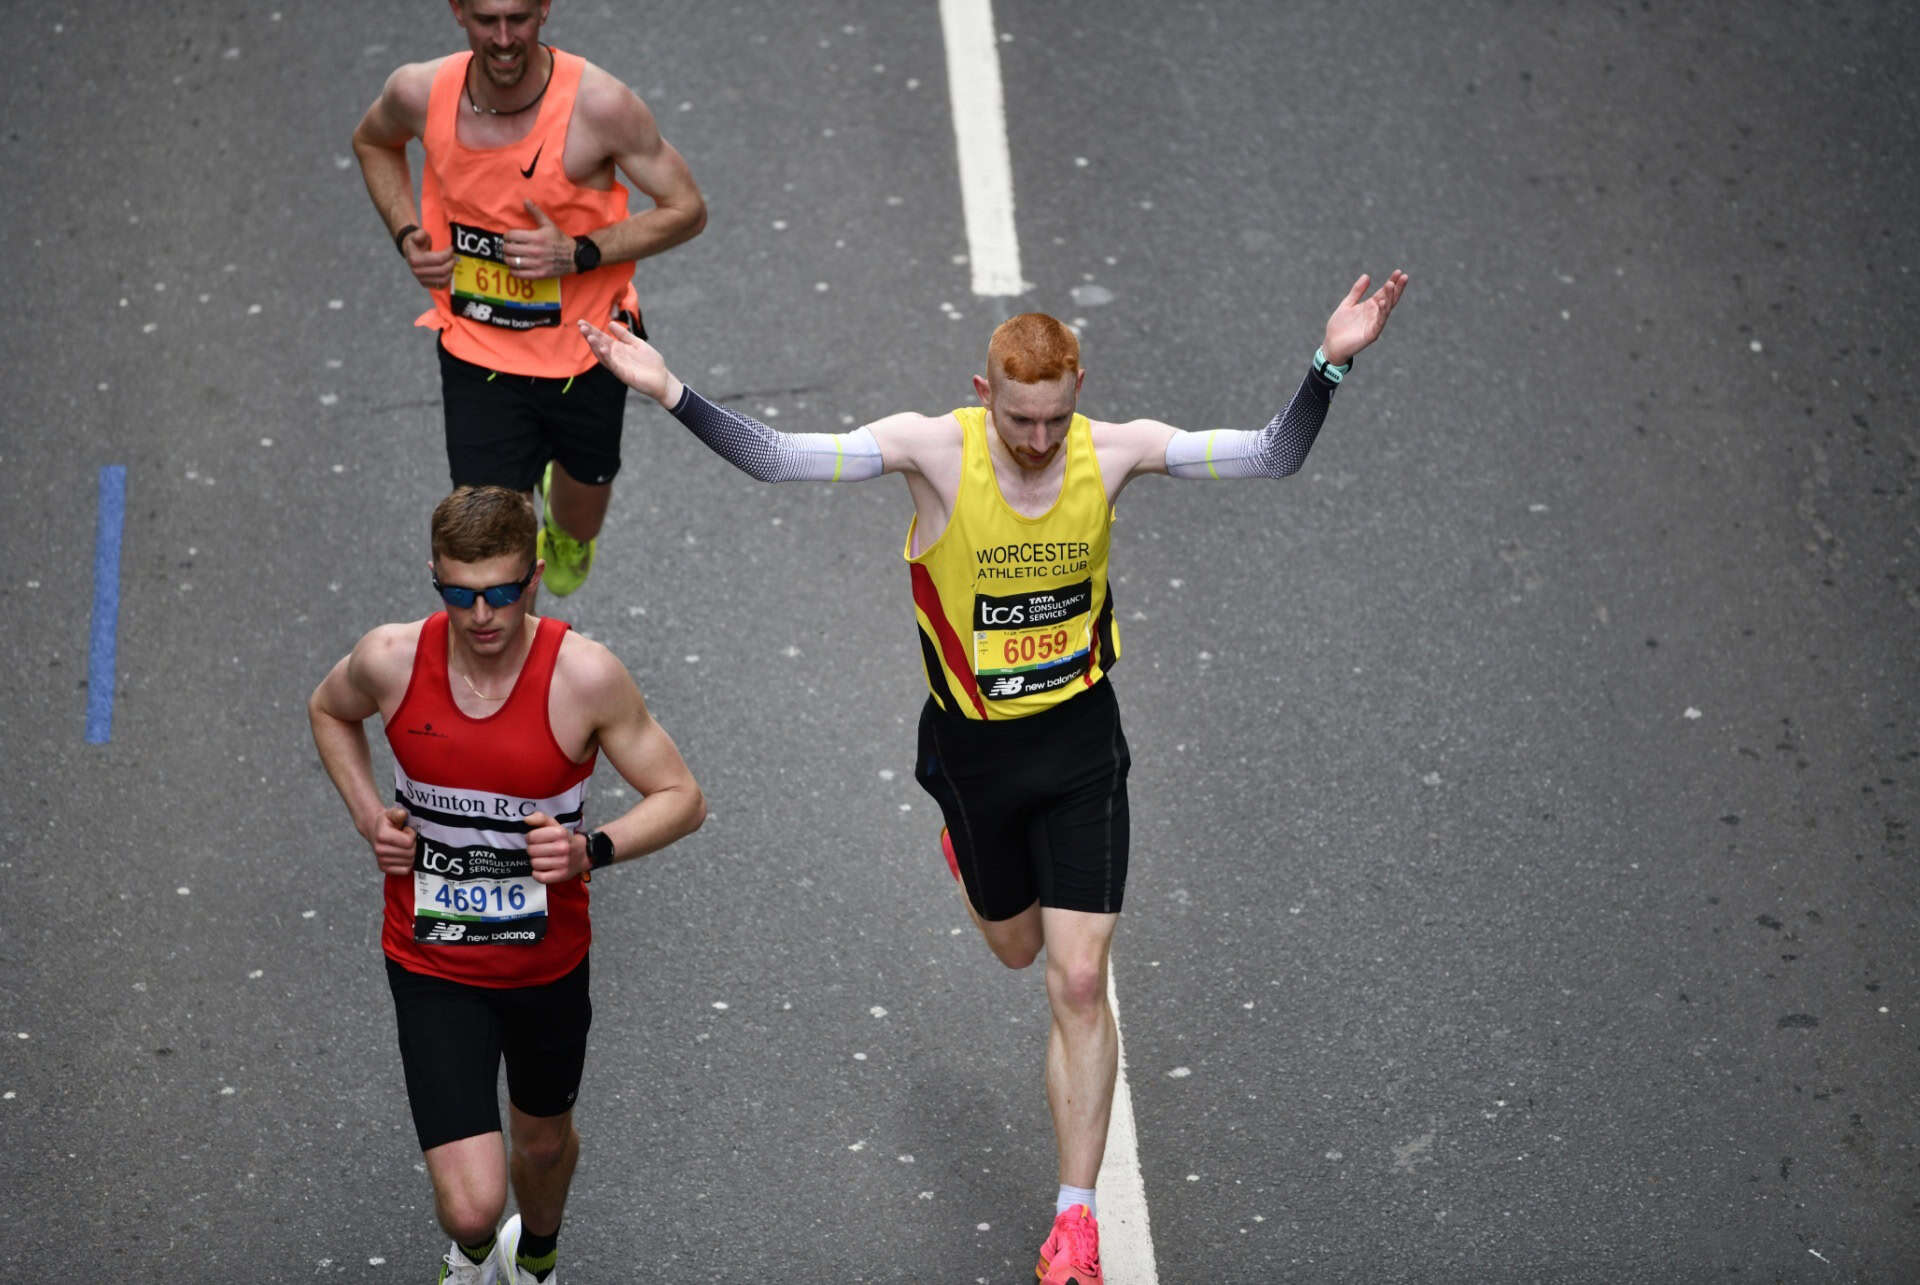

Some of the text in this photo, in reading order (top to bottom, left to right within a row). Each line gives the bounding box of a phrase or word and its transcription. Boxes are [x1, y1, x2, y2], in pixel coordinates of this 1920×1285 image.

[457, 227, 491, 256] tcs
[475, 267, 535, 299] 6108
[976, 542, 1090, 564] WORCESTER
[977, 560, 1088, 580] ATHLETIC CLUB
[1028, 595, 1055, 605] TATA
[1028, 593, 1086, 614] CONSULTANCY
[982, 601, 1025, 625] tcs
[1029, 608, 1068, 622] SERVICES
[1003, 629, 1068, 665] 6059
[1024, 682, 1046, 693] new
[406, 780, 485, 812] Swinton
[422, 842, 464, 875] tcs
[468, 850, 497, 860] TATA
[469, 866, 512, 874] SERVICES
[434, 884, 526, 913] 46916
[466, 930, 536, 942] new balance
